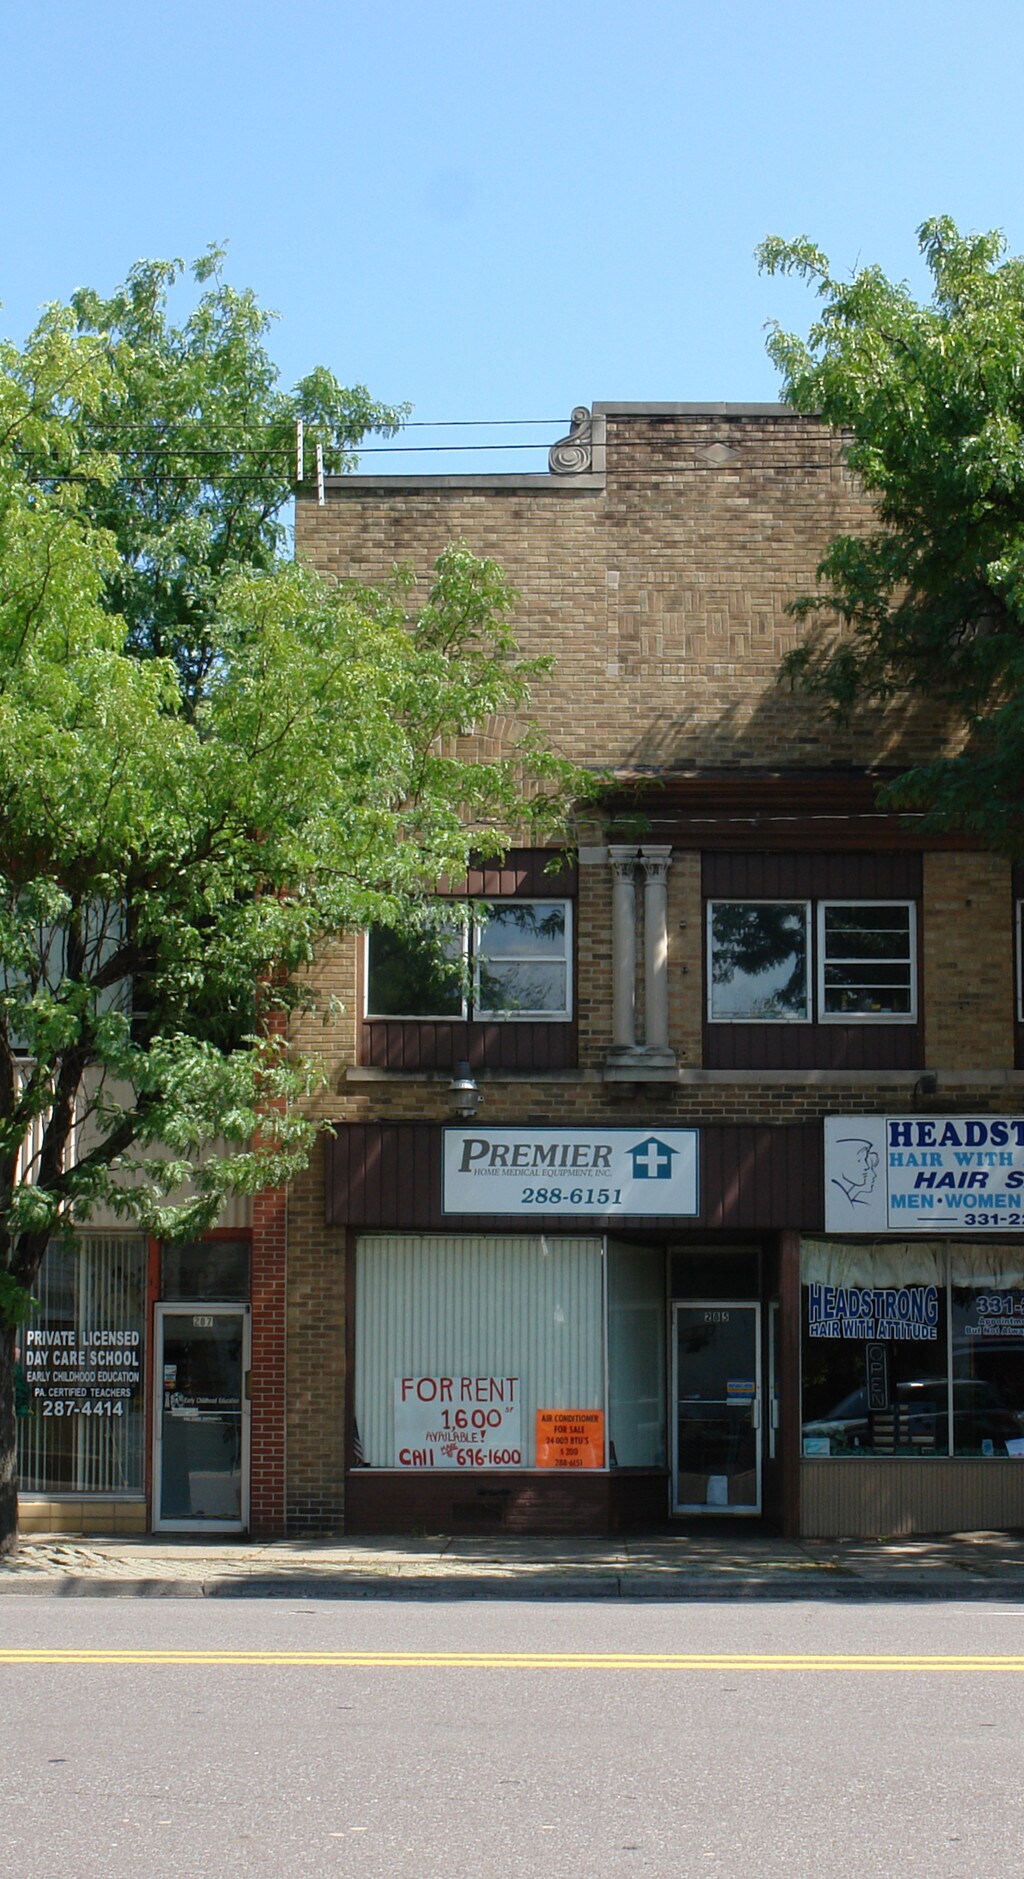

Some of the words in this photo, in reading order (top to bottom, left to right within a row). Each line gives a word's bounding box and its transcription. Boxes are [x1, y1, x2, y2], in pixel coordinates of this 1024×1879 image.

[457, 1138, 613, 1173] PREMIER
[889, 1151, 943, 1167] HAIR
[953, 1151, 1014, 1167] WITH
[473, 1168, 500, 1177] HOME
[501, 1168, 540, 1177] MEDICAL
[594, 1168, 613, 1177] INC.
[913, 1171, 989, 1189] HAIR
[521, 1187, 623, 1205] 288-6151
[890, 1193, 934, 1209] MEN
[944, 1193, 1021, 1209] WOMEN
[808, 1281, 938, 1326] HEADSTRONG
[193, 1316, 213, 1327] 287
[808, 1320, 841, 1338] HAIR
[841, 1318, 876, 1339] WITH
[876, 1318, 938, 1340] ATTITUDE
[26, 1330, 76, 1346] PRIVATE
[82, 1330, 140, 1346] LICENSED
[964, 1325, 982, 1336] But
[982, 1326, 1001, 1336] Not
[26, 1350, 49, 1366] DAY
[52, 1350, 86, 1366] CARE
[90, 1350, 139, 1366] SCHOOL
[26, 1371, 50, 1382] EARLY
[52, 1371, 96, 1382] CHILDHOOD
[97, 1371, 140, 1382] EDUCATION
[869, 1346, 884, 1406] OPEN
[34, 1387, 47, 1397] PA.
[48, 1387, 87, 1397] CERTIFIED
[90, 1387, 131, 1397] TEACHERS
[401, 1377, 454, 1402] FOR
[461, 1377, 519, 1402] RENT
[42, 1401, 124, 1417] 287-4414
[441, 1408, 502, 1432] 1,600
[541, 1414, 553, 1422] AIR
[554, 1414, 599, 1423] CONDITIONER
[554, 1425, 567, 1433] FOR
[569, 1425, 585, 1433] SALE
[456, 1448, 522, 1466] 696-1600
